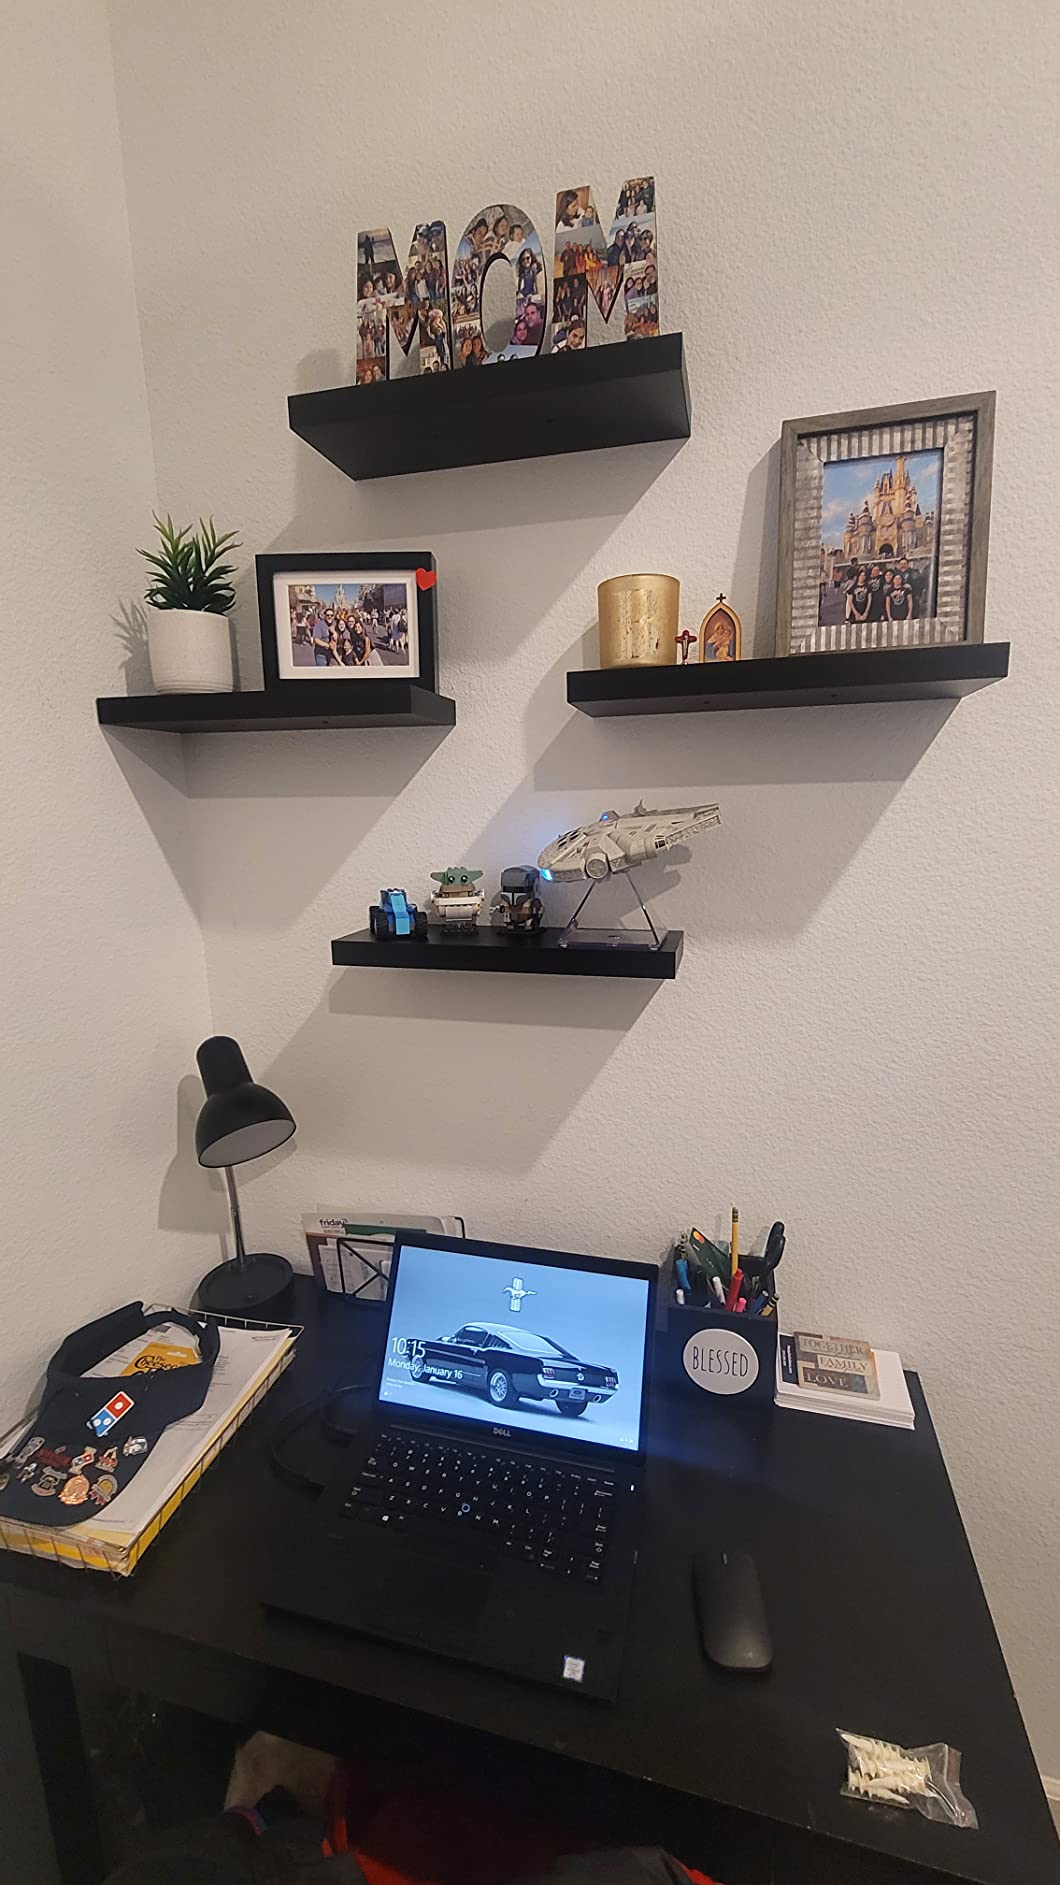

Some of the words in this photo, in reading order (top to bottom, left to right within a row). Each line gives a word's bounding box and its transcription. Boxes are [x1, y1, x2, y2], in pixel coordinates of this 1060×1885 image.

[356, 176, 660, 386] MOM
[392, 1337, 426, 1358] 10:15
[802, 1339, 864, 1354] TOGETHER
[692, 1346, 748, 1377] BLESSED
[819, 1357, 867, 1371] FAMILY
[422, 1364, 452, 1379] January
[454, 1369, 463, 1379] 16
[807, 1373, 848, 1388] LOVE
